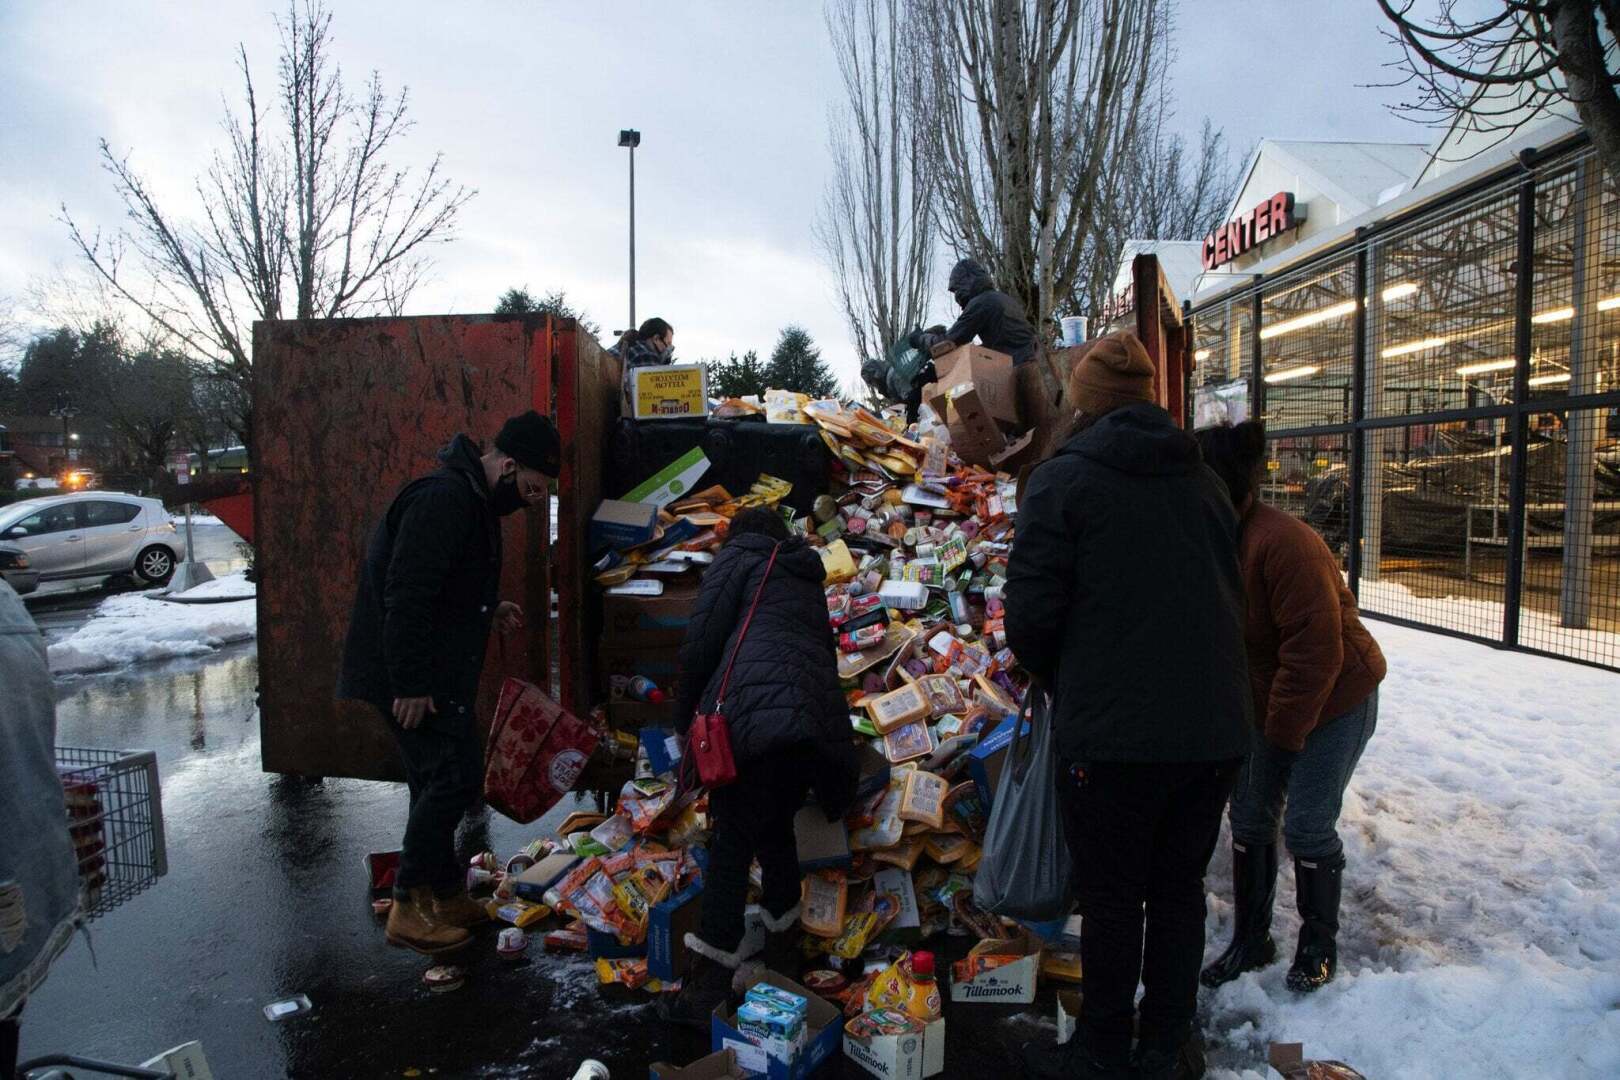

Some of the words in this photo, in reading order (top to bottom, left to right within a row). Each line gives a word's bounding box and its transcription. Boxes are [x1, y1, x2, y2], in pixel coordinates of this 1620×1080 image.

[1202, 192, 1290, 271] CENTER
[962, 984, 1023, 998] Tillamook
[848, 1041, 889, 1074] Tillamook
